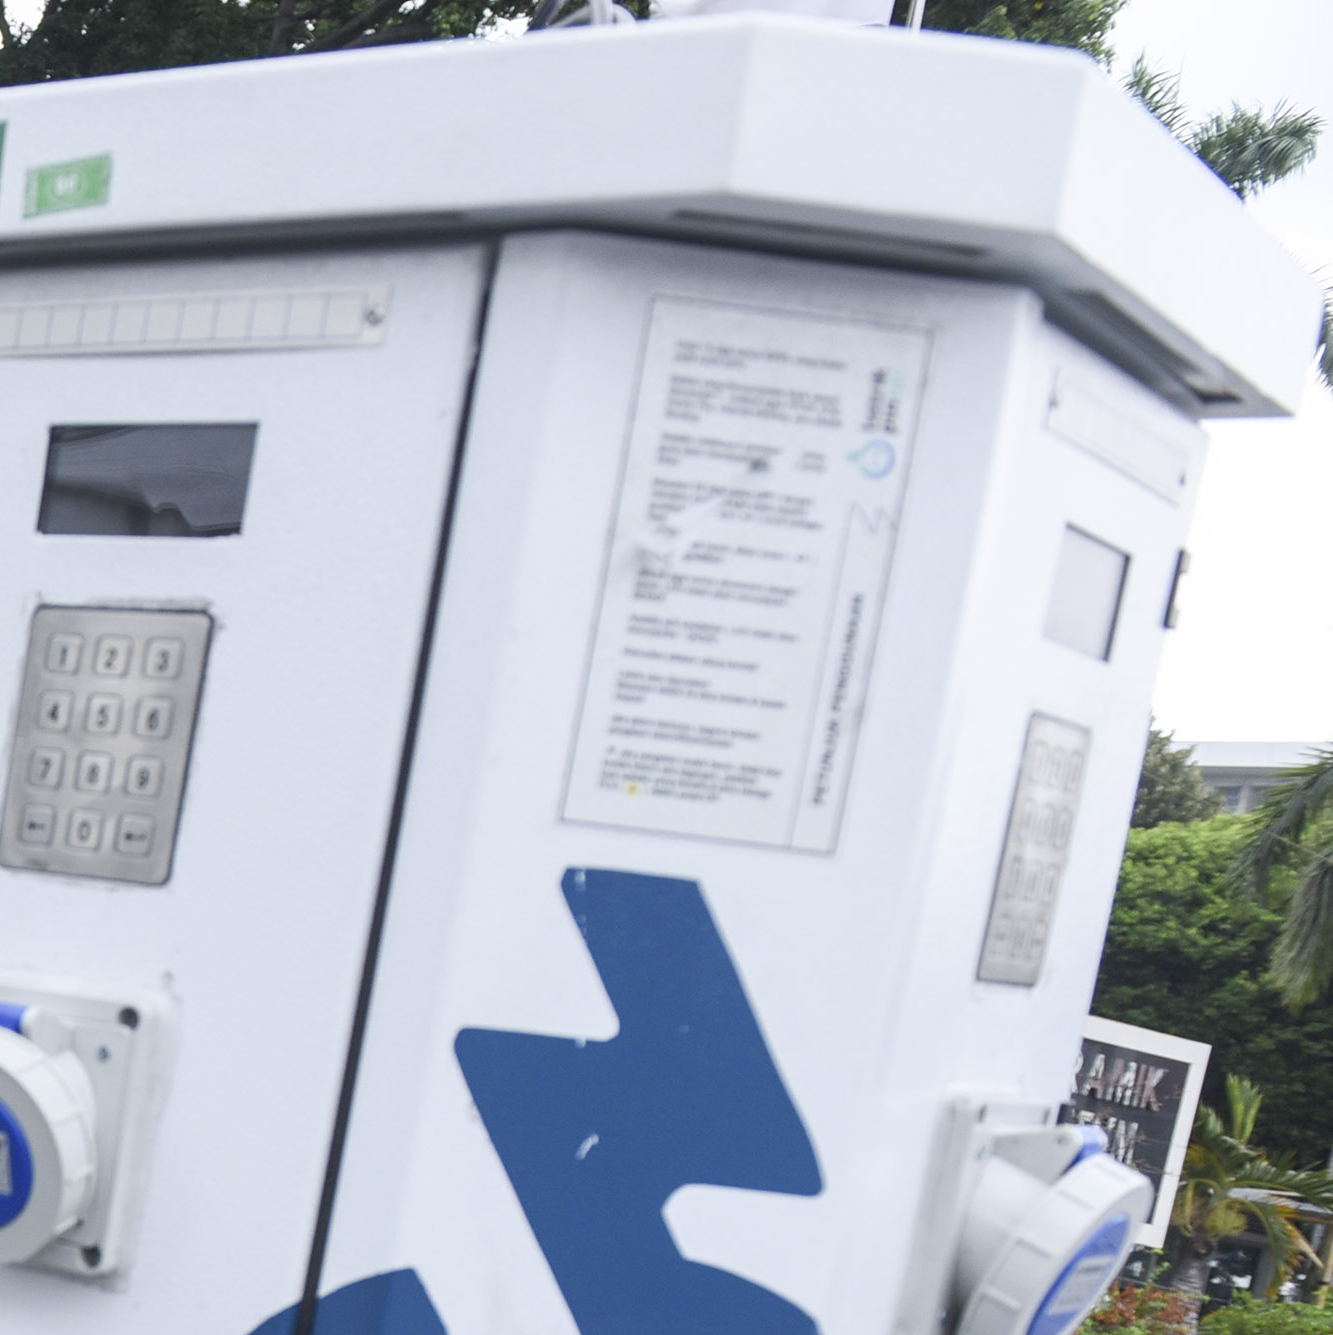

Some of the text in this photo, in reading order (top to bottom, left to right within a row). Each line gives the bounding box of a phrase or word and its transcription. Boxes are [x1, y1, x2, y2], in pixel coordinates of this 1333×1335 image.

[59, 645, 171, 673] 1 2 3
[47, 702, 160, 731] 4 5 6
[40, 757, 53, 780] 7
[137, 767, 151, 789] 9
[77, 820, 92, 843] 0
